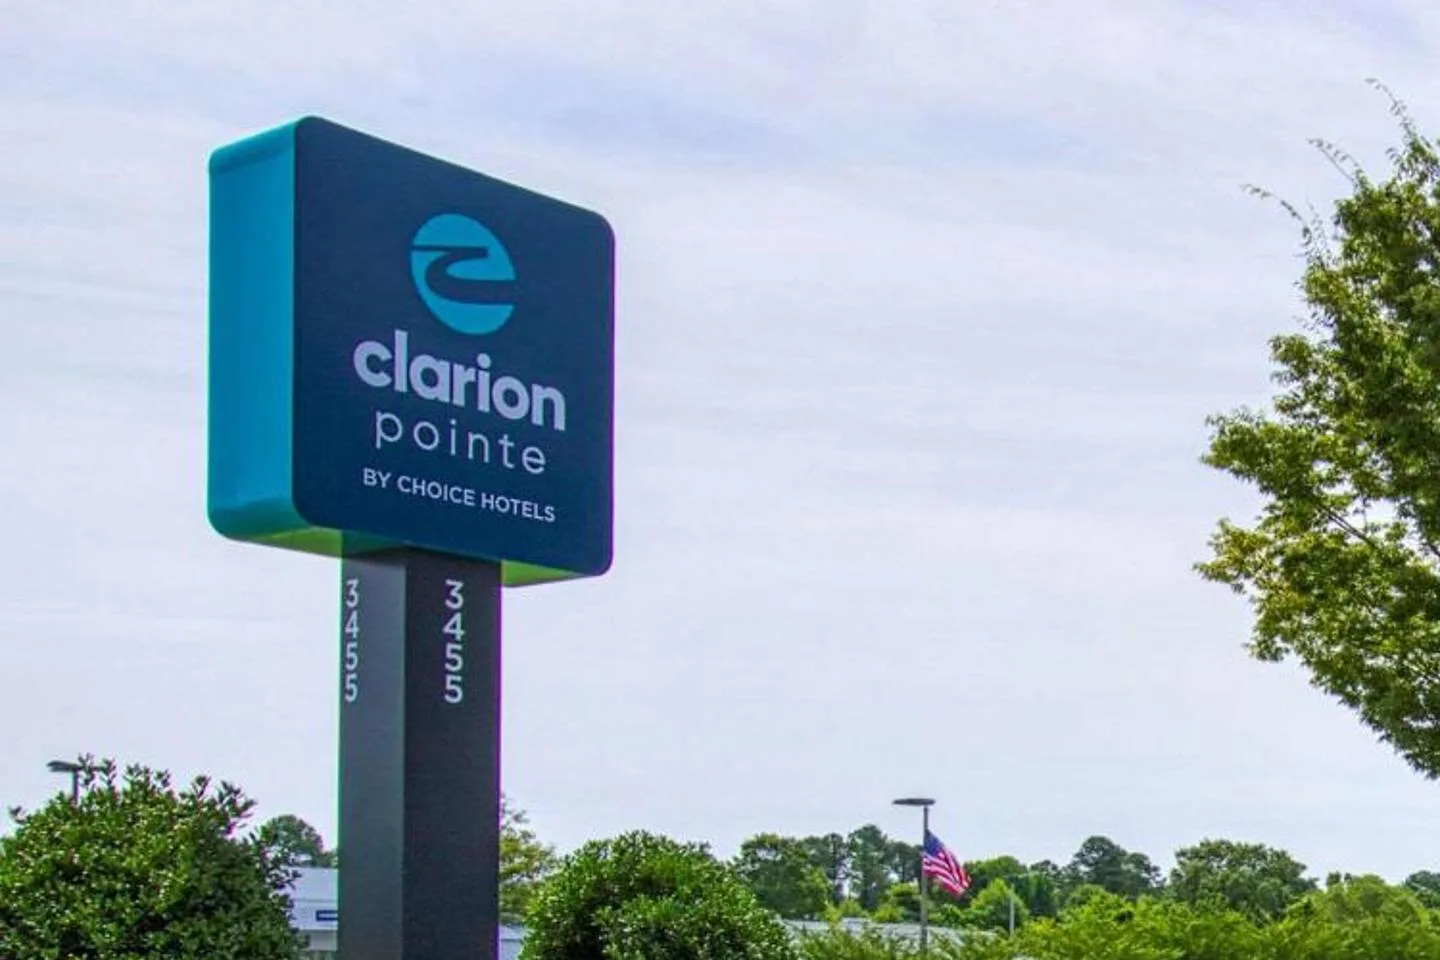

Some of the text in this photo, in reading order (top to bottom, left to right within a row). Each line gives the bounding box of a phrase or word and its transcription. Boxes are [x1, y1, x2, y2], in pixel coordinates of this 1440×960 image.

[353, 329, 566, 431] clarion
[375, 410, 546, 475] pointe
[363, 468, 556, 522] BY CHOICE HOTELS
[345, 578, 360, 702] 3455
[442, 579, 465, 703] 3455
